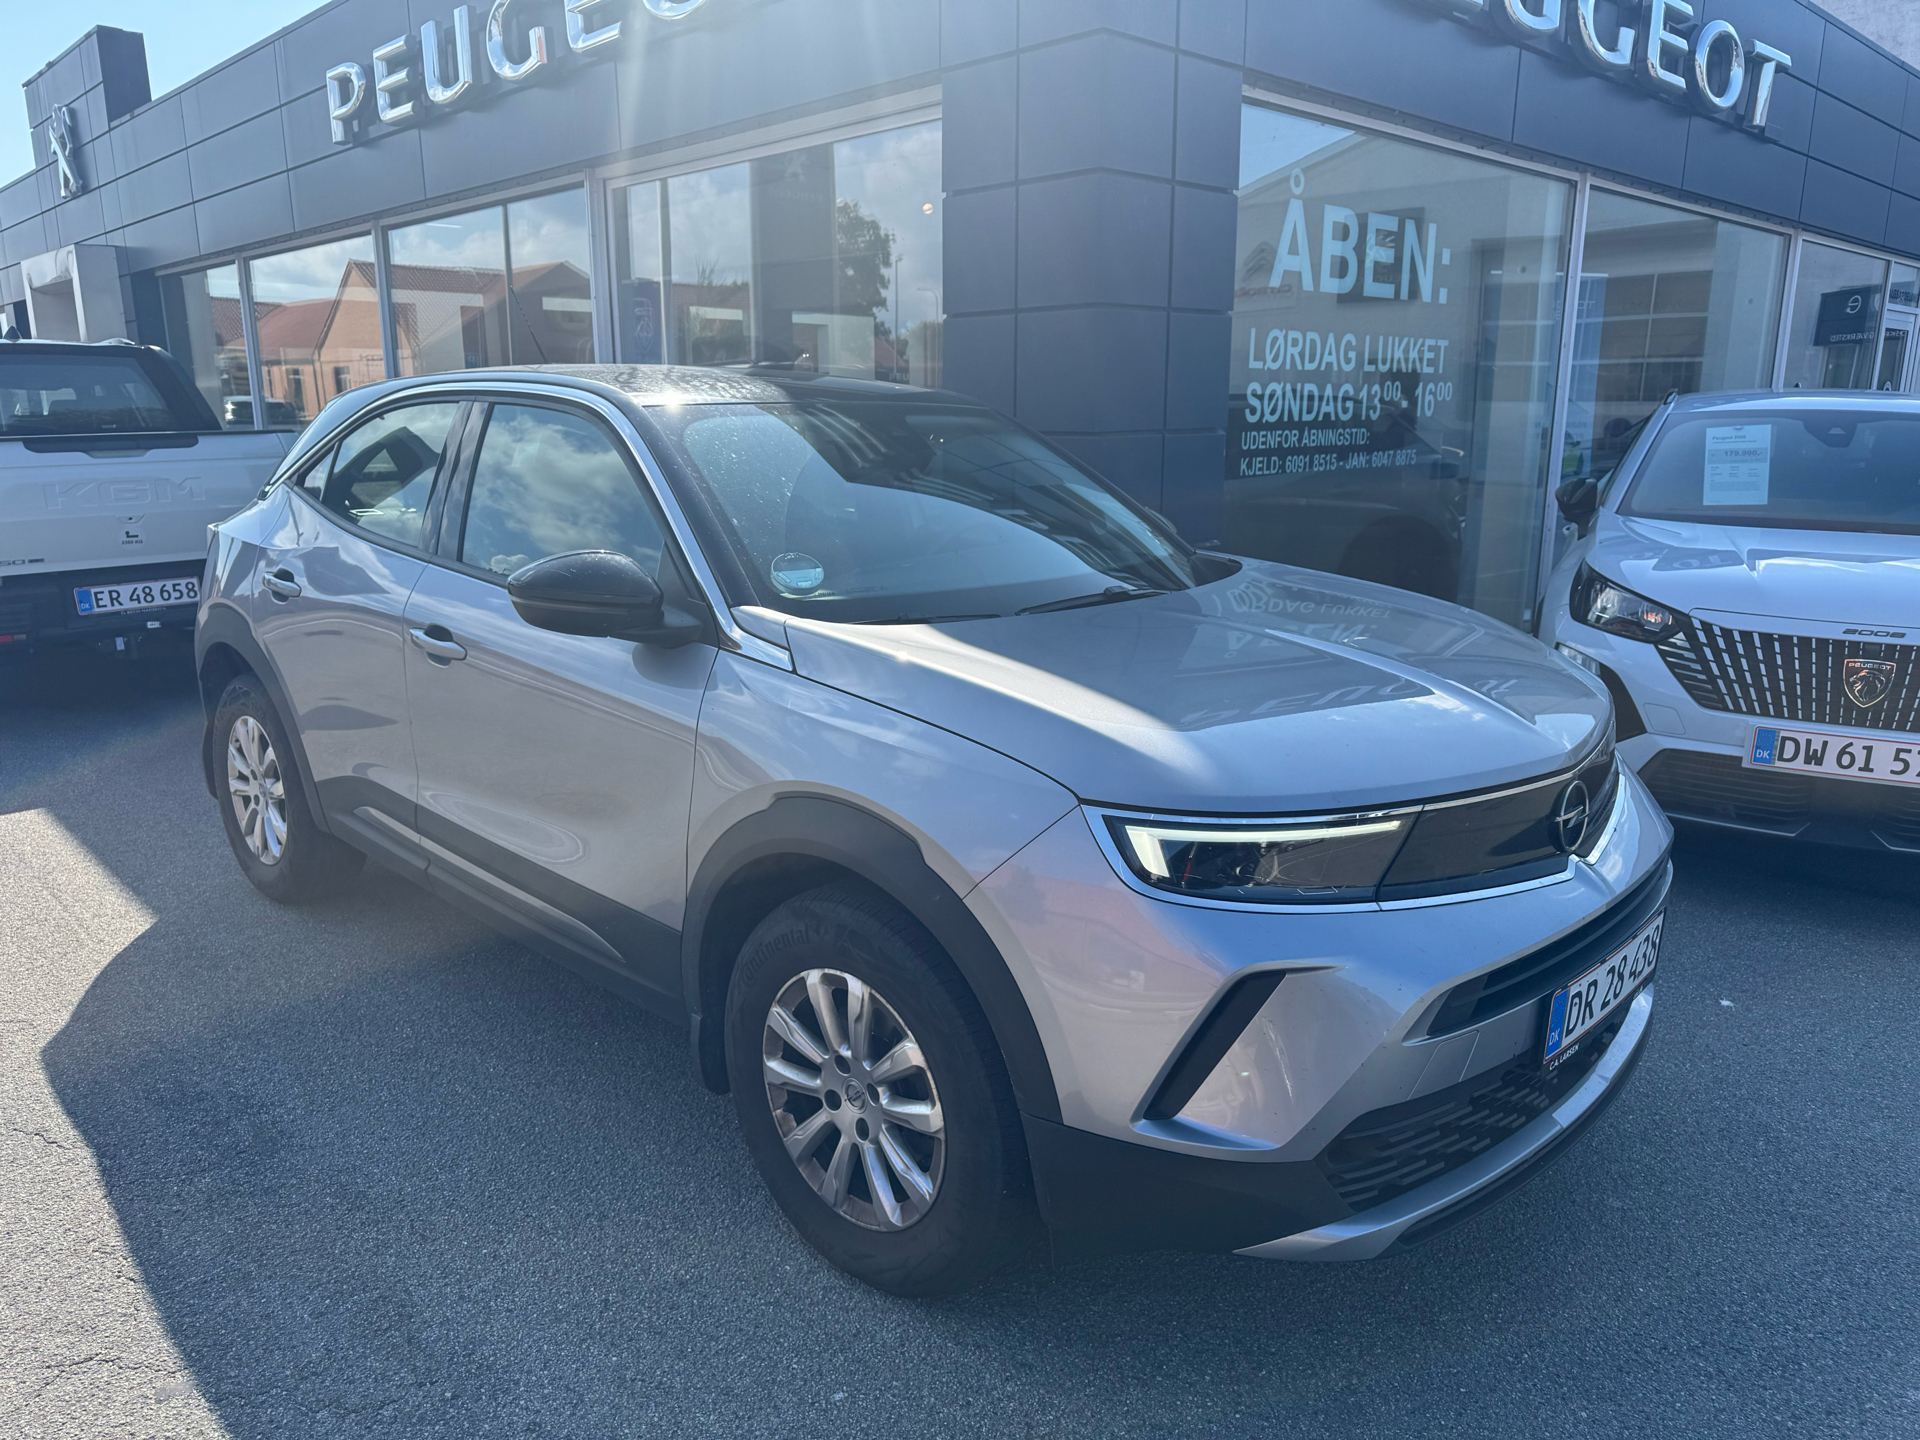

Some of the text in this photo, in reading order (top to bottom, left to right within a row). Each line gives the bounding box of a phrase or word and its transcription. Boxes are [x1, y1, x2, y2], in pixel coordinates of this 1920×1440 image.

[326, 0, 704, 145] PEUGE
[1268, 168, 1451, 304] ÅBEN:
[1248, 327, 1449, 374] LØRDAG LUKKET
[1244, 381, 1355, 424] SØNDAG
[1241, 426, 1370, 450] UDENFOR ÅBNINGSTID:
[1239, 456, 1282, 476] KJELD:
[1285, 455, 1309, 473] 6091
[1312, 453, 1337, 472] 8515
[1345, 452, 1369, 469] JAN:
[1371, 450, 1394, 468] 6047
[1395, 449, 1417, 466] 8875
[43, 477, 206, 510] KGM
[81, 581, 199, 610] DK ER 48 658
[1842, 628, 1907, 639] 2008
[1848, 662, 1892, 671] PEUGEOT
[1755, 735, 1920, 778] DK DW 61 5
[742, 921, 811, 989] Continental
[1548, 924, 1660, 1046] DK DR 28 438
[1559, 1043, 1580, 1065] LARSEN
